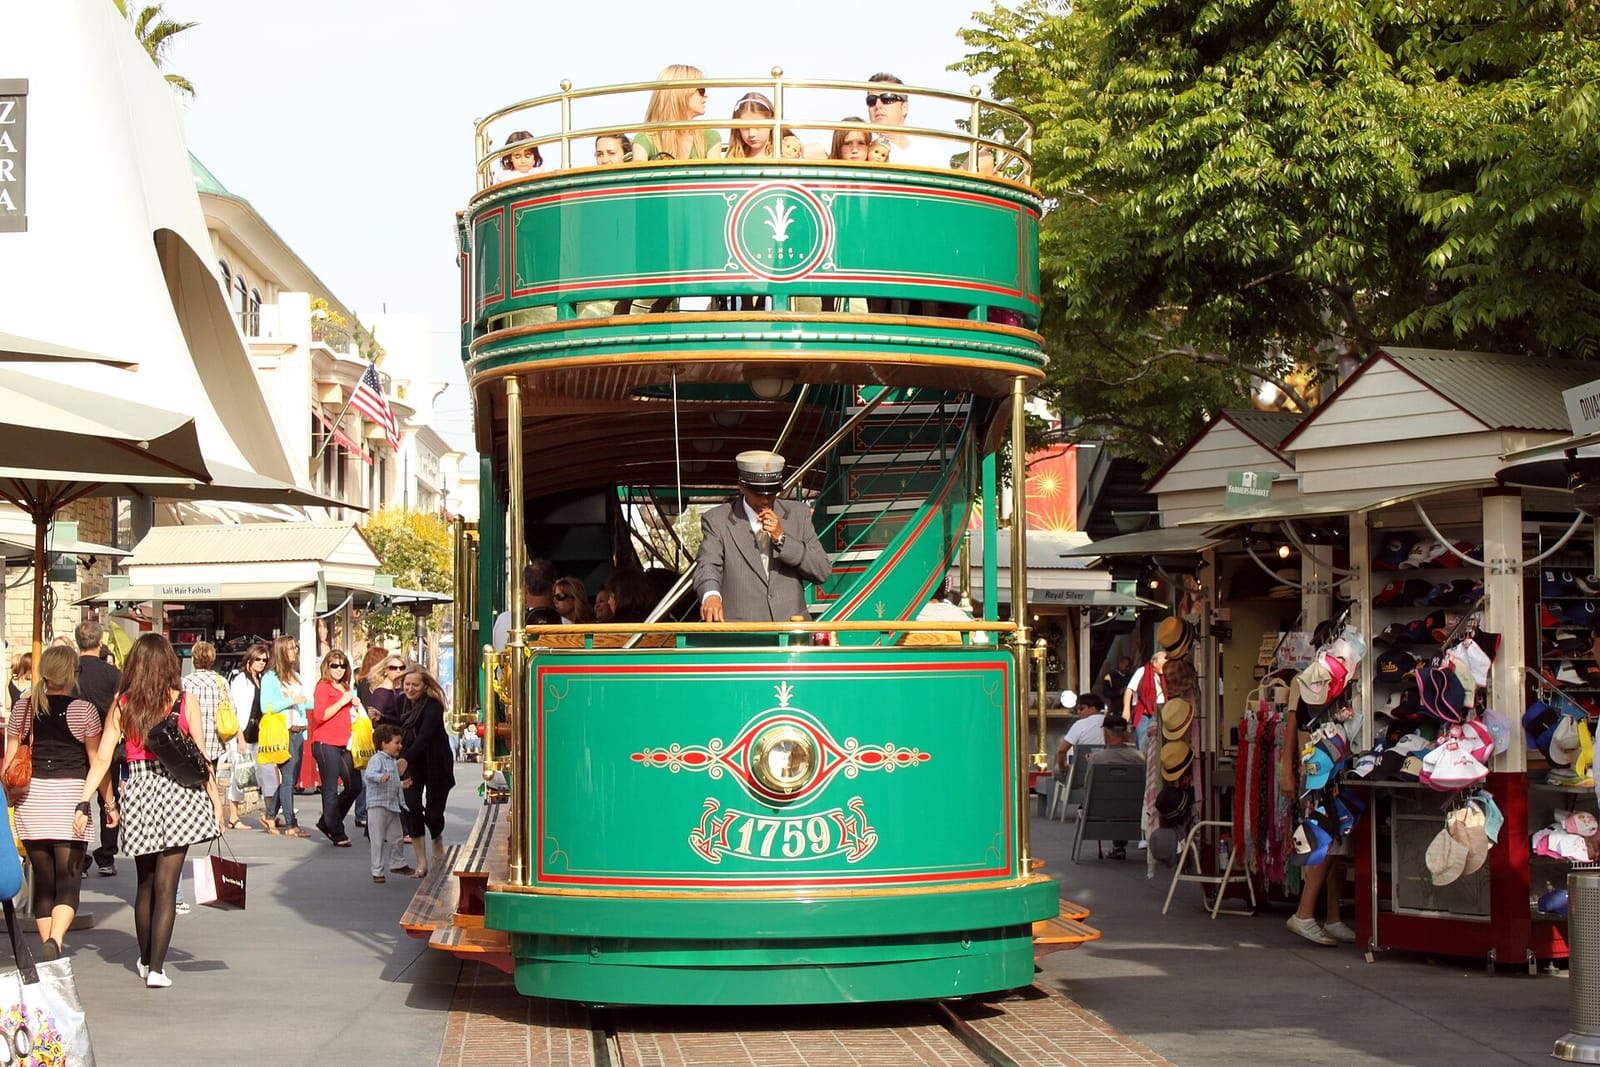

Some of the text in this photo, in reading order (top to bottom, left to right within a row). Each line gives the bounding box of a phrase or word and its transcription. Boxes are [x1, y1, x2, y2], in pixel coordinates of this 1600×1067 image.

[0, 101, 18, 211] ZARA
[174, 586, 187, 594] Hair
[187, 586, 211, 594] Fashion
[1045, 591, 1085, 600] Royal Silver
[734, 816, 831, 858] 1759
